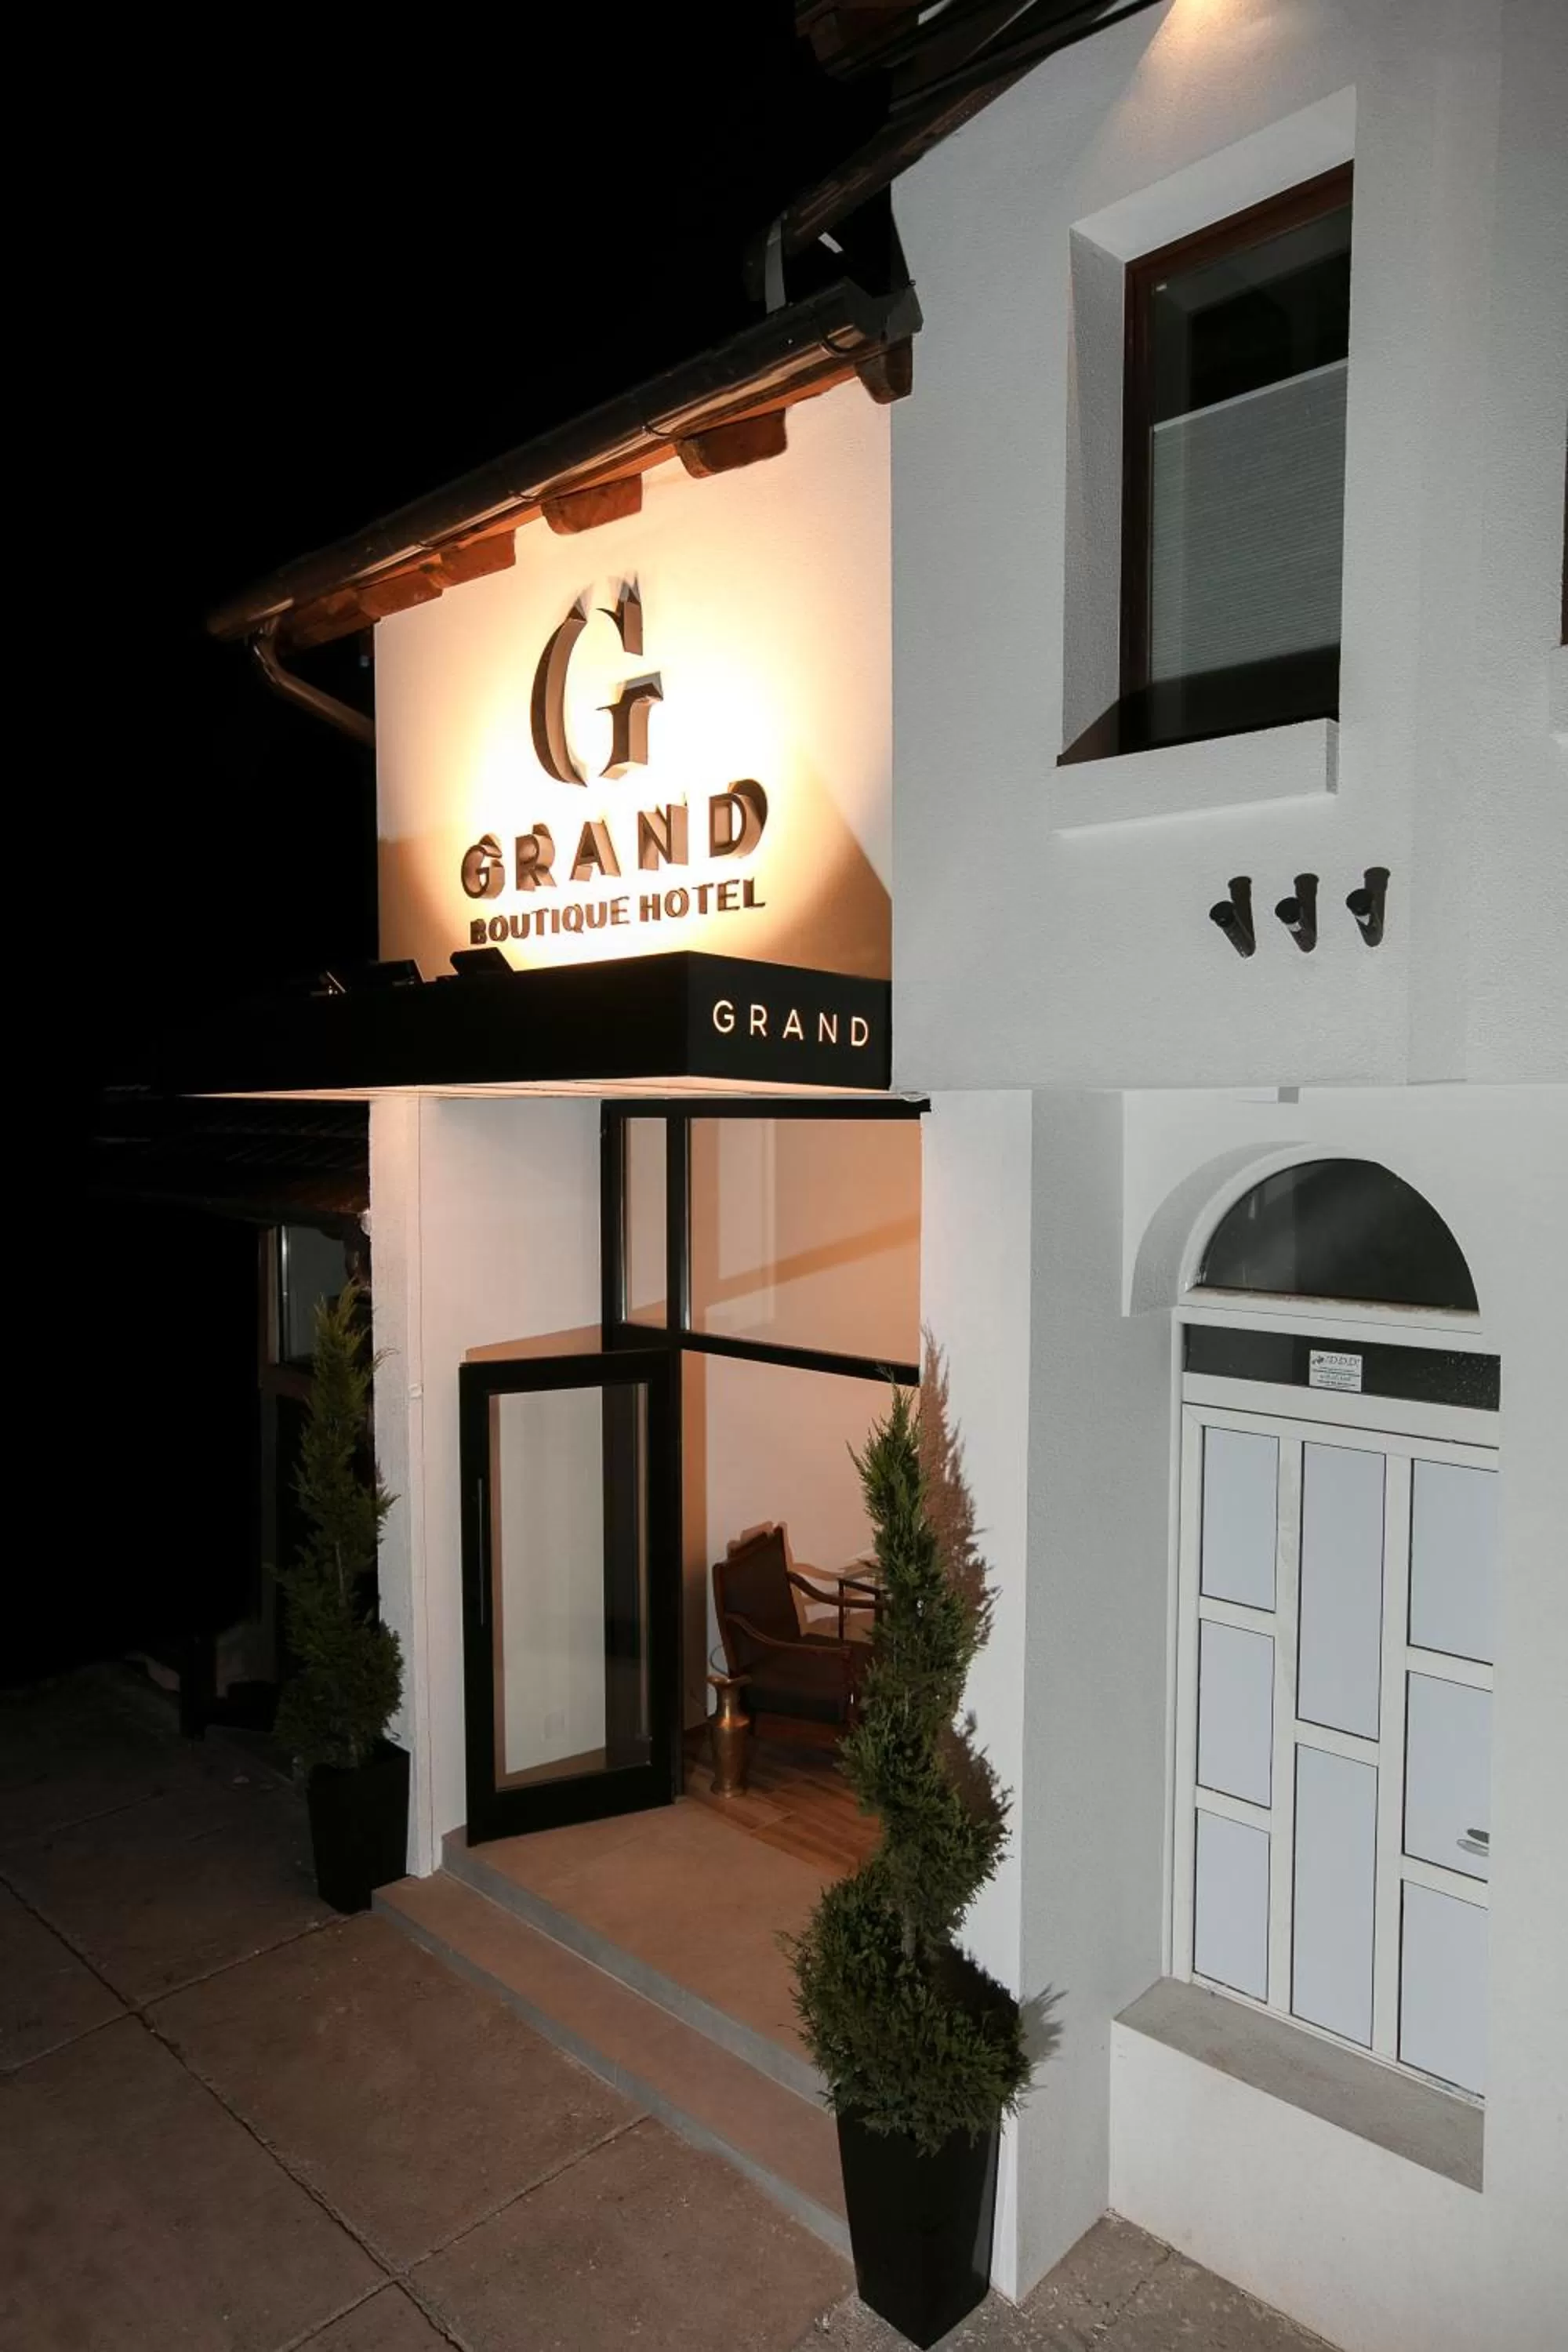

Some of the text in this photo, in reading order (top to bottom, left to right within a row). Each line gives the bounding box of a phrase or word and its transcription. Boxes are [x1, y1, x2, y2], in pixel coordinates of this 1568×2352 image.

[530, 579, 663, 787] G
[461, 779, 768, 899] GRAND
[470, 877, 766, 945] BOUTIQUE HOTEL
[713, 1000, 869, 1047] GRAND
